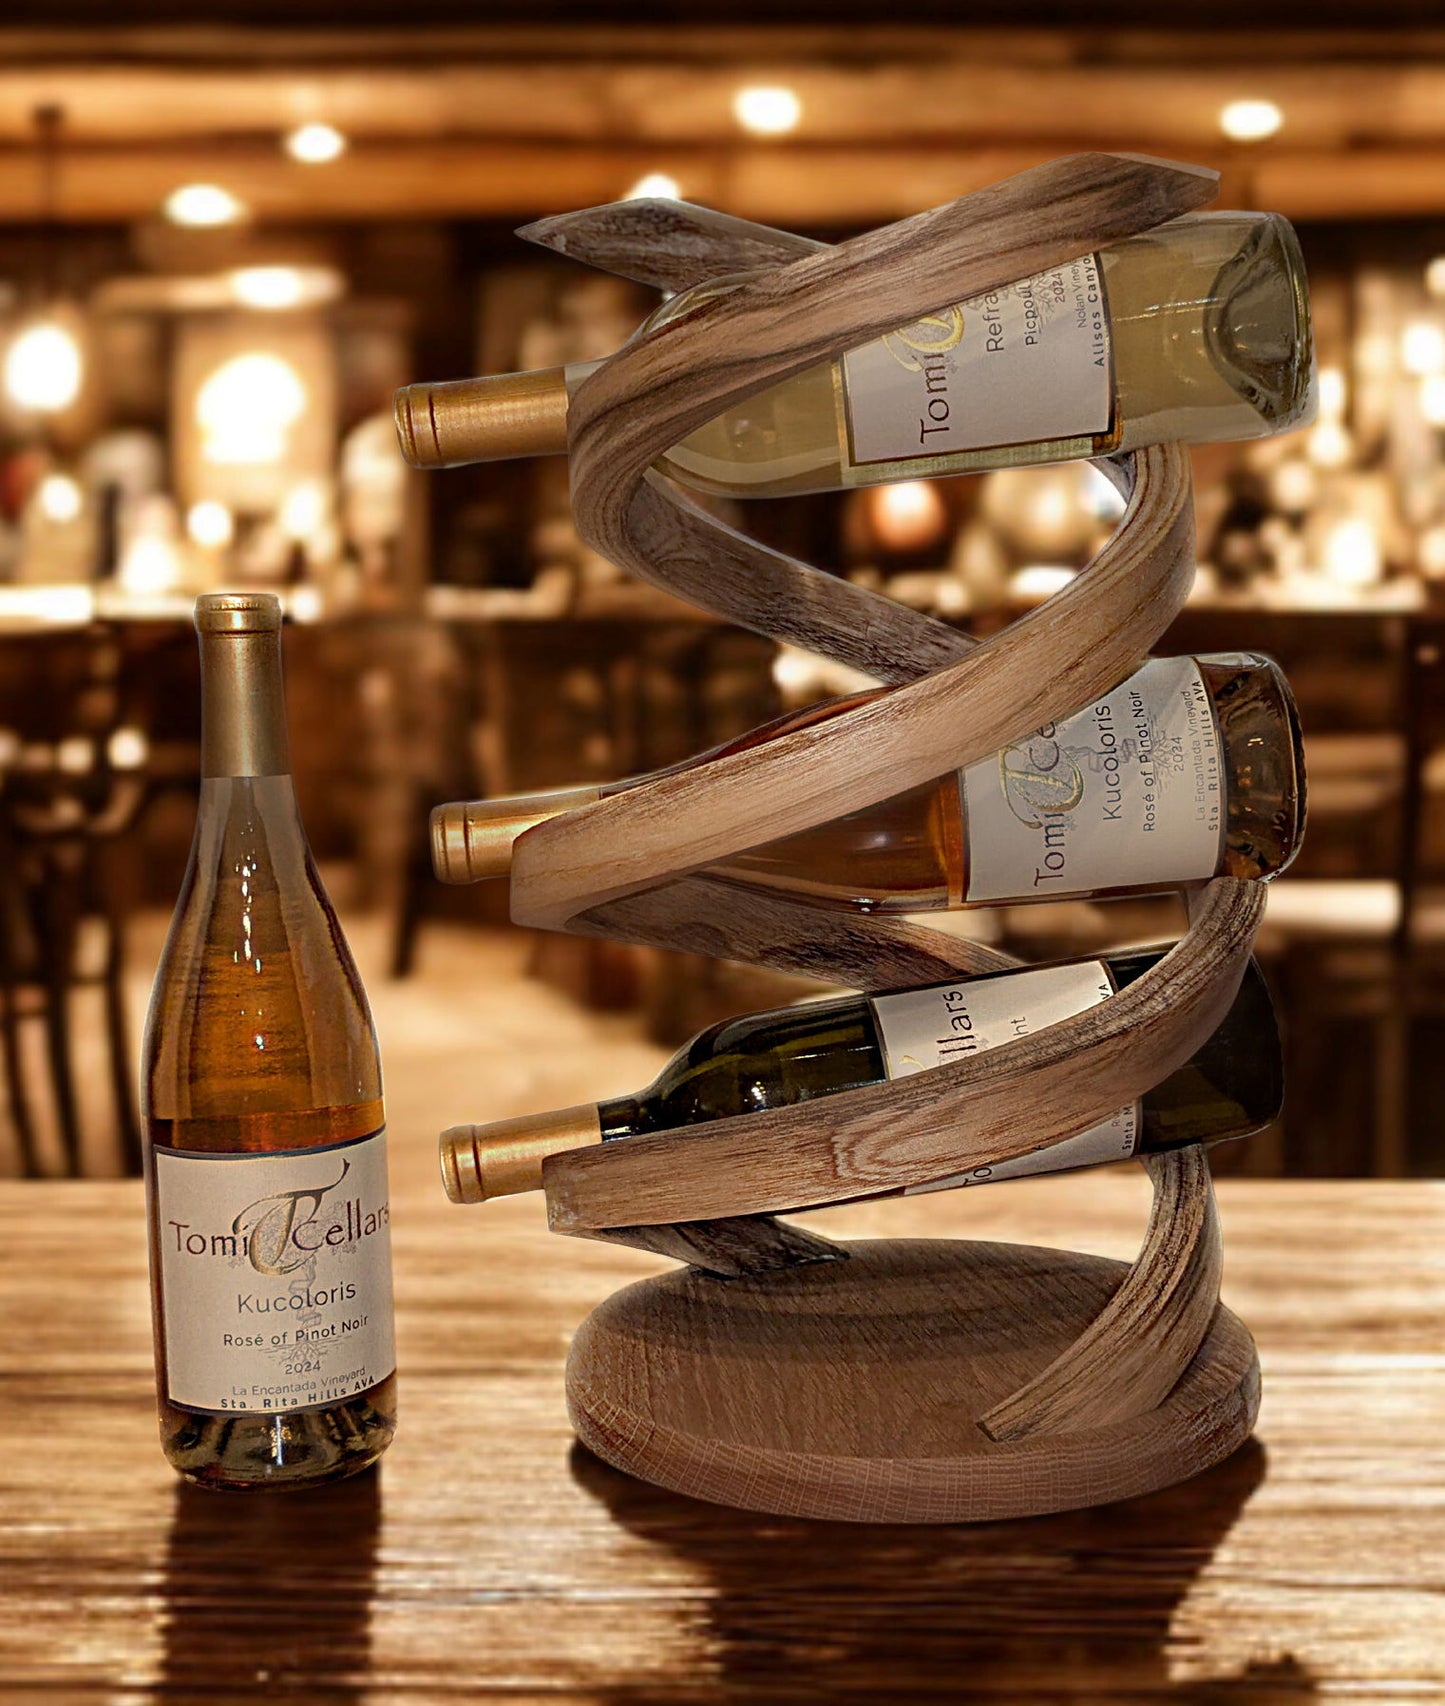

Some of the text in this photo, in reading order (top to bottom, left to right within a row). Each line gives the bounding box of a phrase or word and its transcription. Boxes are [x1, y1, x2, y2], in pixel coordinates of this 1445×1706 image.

[1052, 272, 1066, 303] 2024
[982, 292, 1005, 352] Refra
[1072, 294, 1088, 328] Nolan
[1083, 257, 1105, 368] Alisos Canyo
[911, 351, 950, 444] Tomi
[1092, 704, 1122, 821] Kucoloris
[1128, 690, 1156, 831] Rosé of Pinot Noir
[1170, 735, 1184, 772] 2024
[1180, 689, 1206, 821] La Encantada Vineyard
[1191, 680, 1219, 831] Sta. Rita Hills AVA
[1033, 813, 1065, 887] Tomi
[1097, 983, 1110, 1000] VA
[936, 991, 977, 1055] llars
[1121, 1121, 1134, 1150] Santa
[961, 1160, 993, 1187] To
[168, 1197, 389, 1257] Tomi Cellars
[237, 1281, 357, 1314] Kucoloris
[223, 1314, 369, 1347] Rosé of Pinot Noir
[232, 1366, 366, 1396] La Encantada Vineyard
[285, 1359, 322, 1375] 2024
[220, 1375, 375, 1409] Sta. Rita Hills AVA
